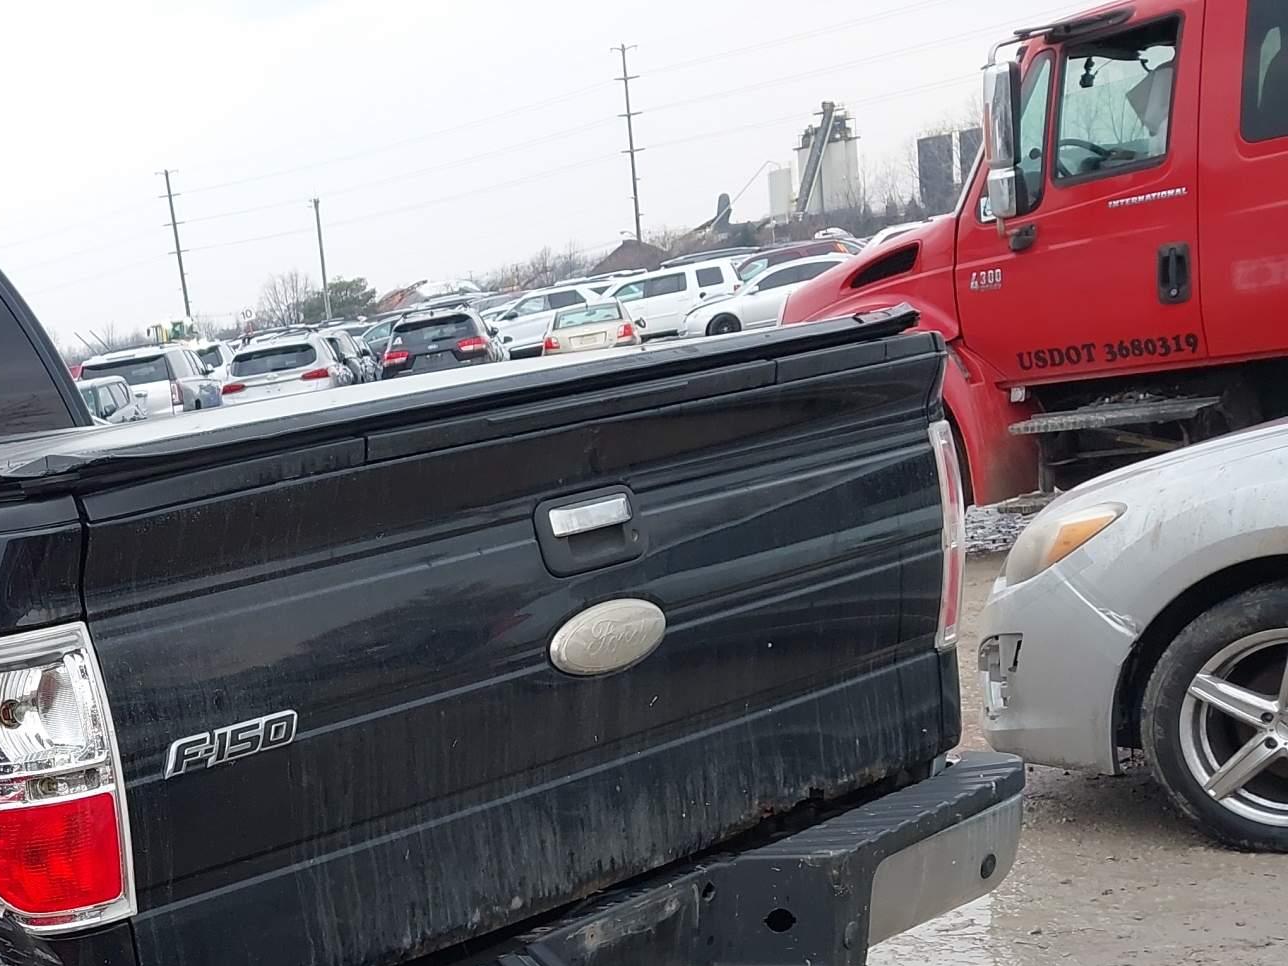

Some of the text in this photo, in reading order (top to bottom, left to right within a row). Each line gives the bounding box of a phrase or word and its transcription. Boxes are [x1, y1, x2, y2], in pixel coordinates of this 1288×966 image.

[1107, 187, 1188, 208] INTERNATIONAL
[970, 267, 1002, 289] 4300
[240, 308, 253, 320] 10
[1016, 332, 1199, 371] USDOT 3680319
[164, 709, 298, 780] F-150
